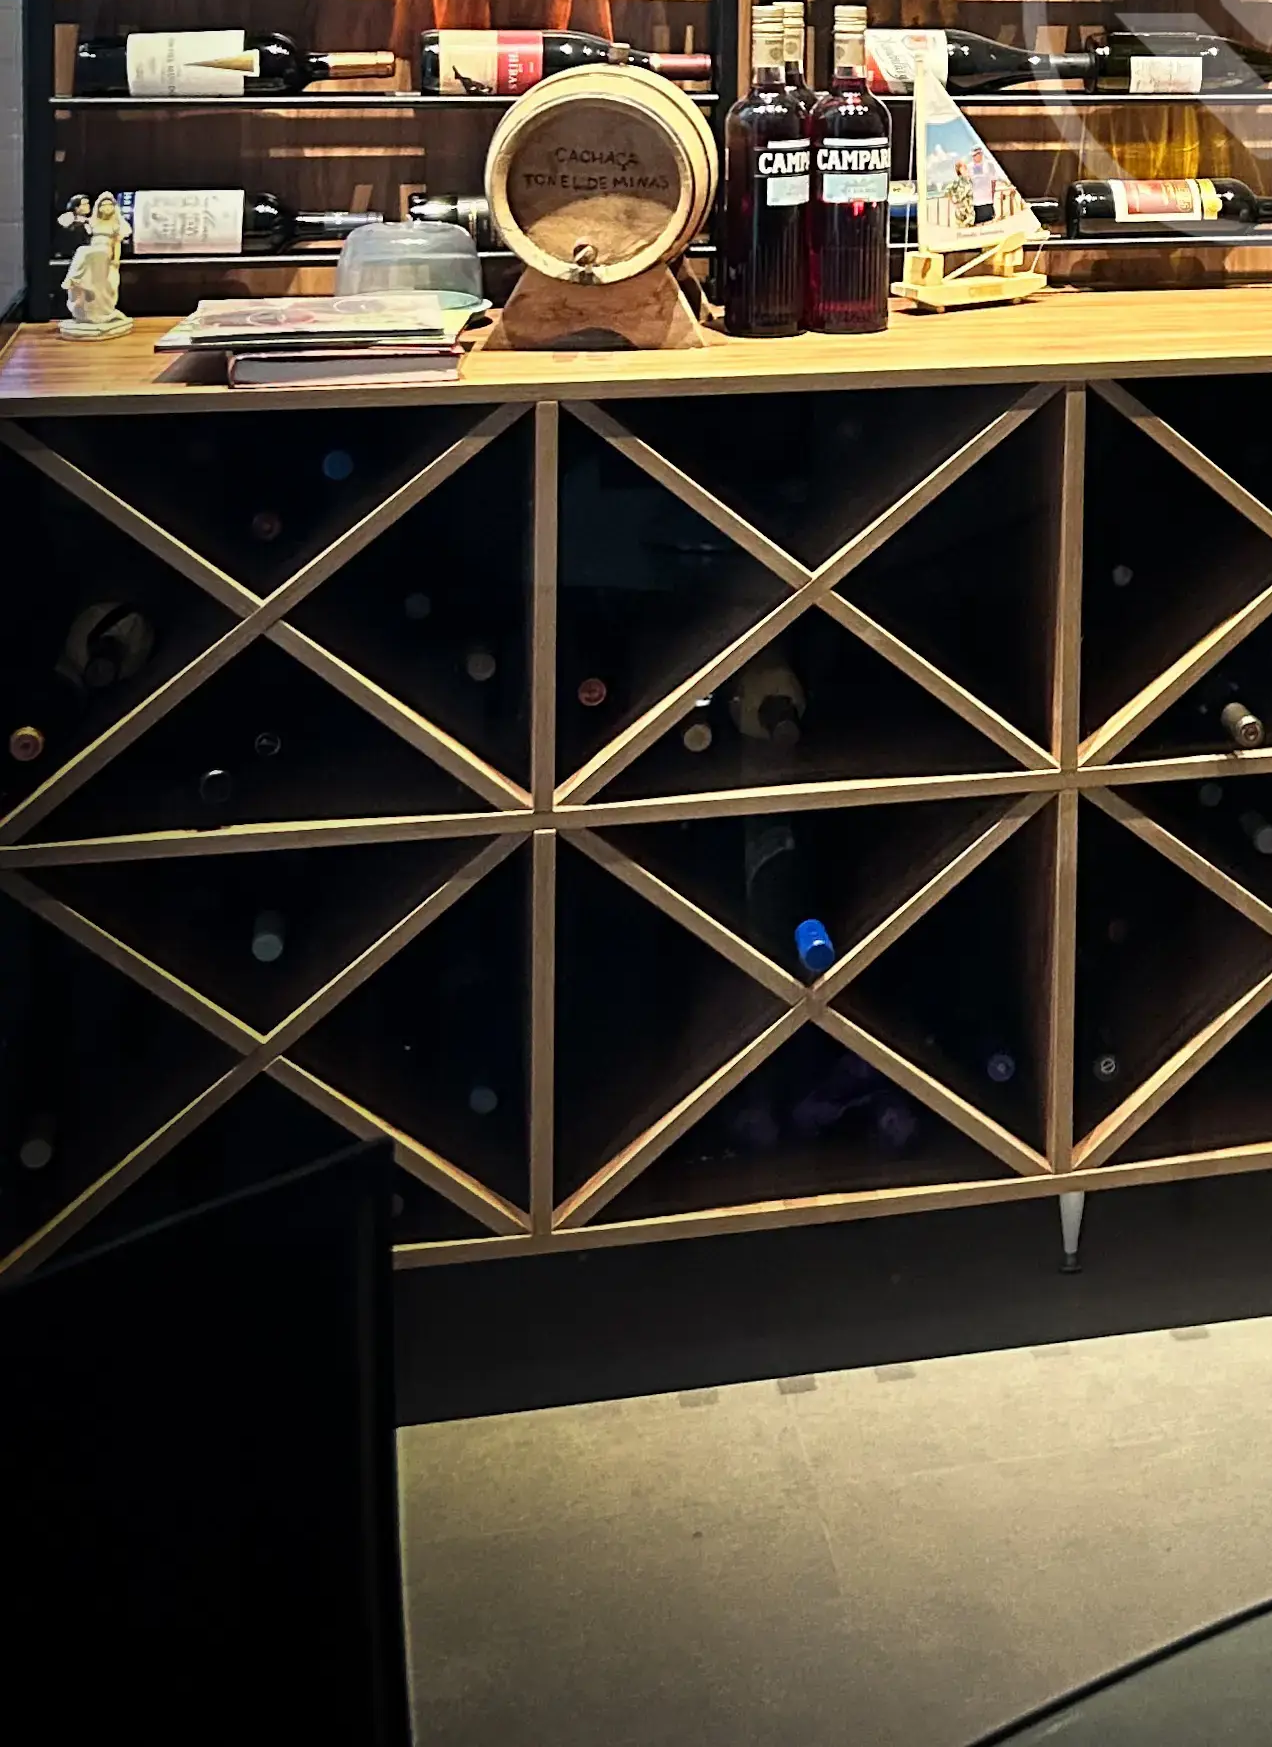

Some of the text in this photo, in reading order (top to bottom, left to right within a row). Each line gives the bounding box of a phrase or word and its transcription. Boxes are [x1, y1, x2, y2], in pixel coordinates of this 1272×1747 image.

[555, 147, 640, 171] CACHAÇA
[758, 151, 811, 174] CAMP
[523, 173, 671, 191] TONEL DE MINAS
